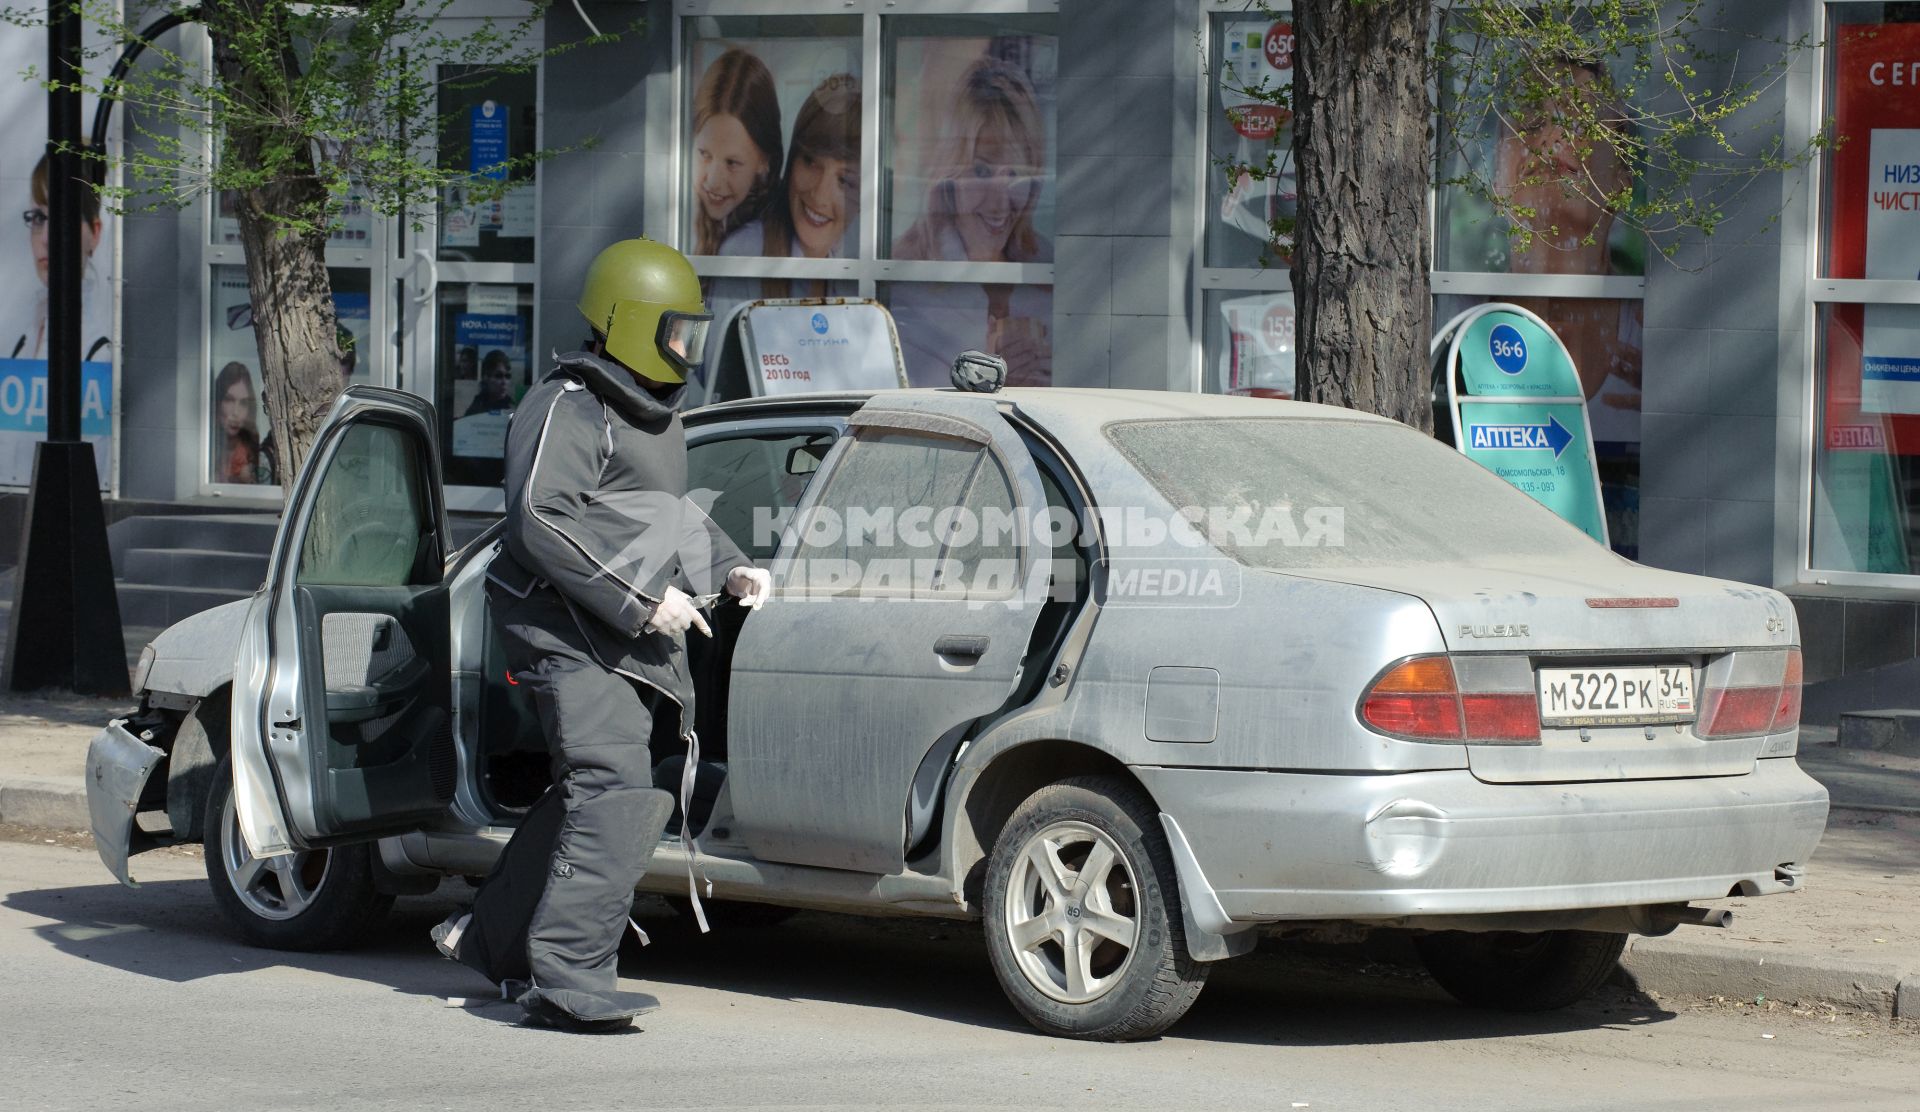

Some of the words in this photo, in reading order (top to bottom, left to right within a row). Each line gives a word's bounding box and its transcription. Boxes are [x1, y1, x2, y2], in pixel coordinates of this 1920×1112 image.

[762, 354, 789, 366] ВЕСЬ
[766, 369, 791, 380] 2010
[792, 371, 811, 381] год
[1474, 427, 1550, 448] АПТЕКА
[1458, 623, 1530, 638] PULSAR
[1659, 668, 1684, 697] 34
[1659, 699, 1677, 709] RUS
